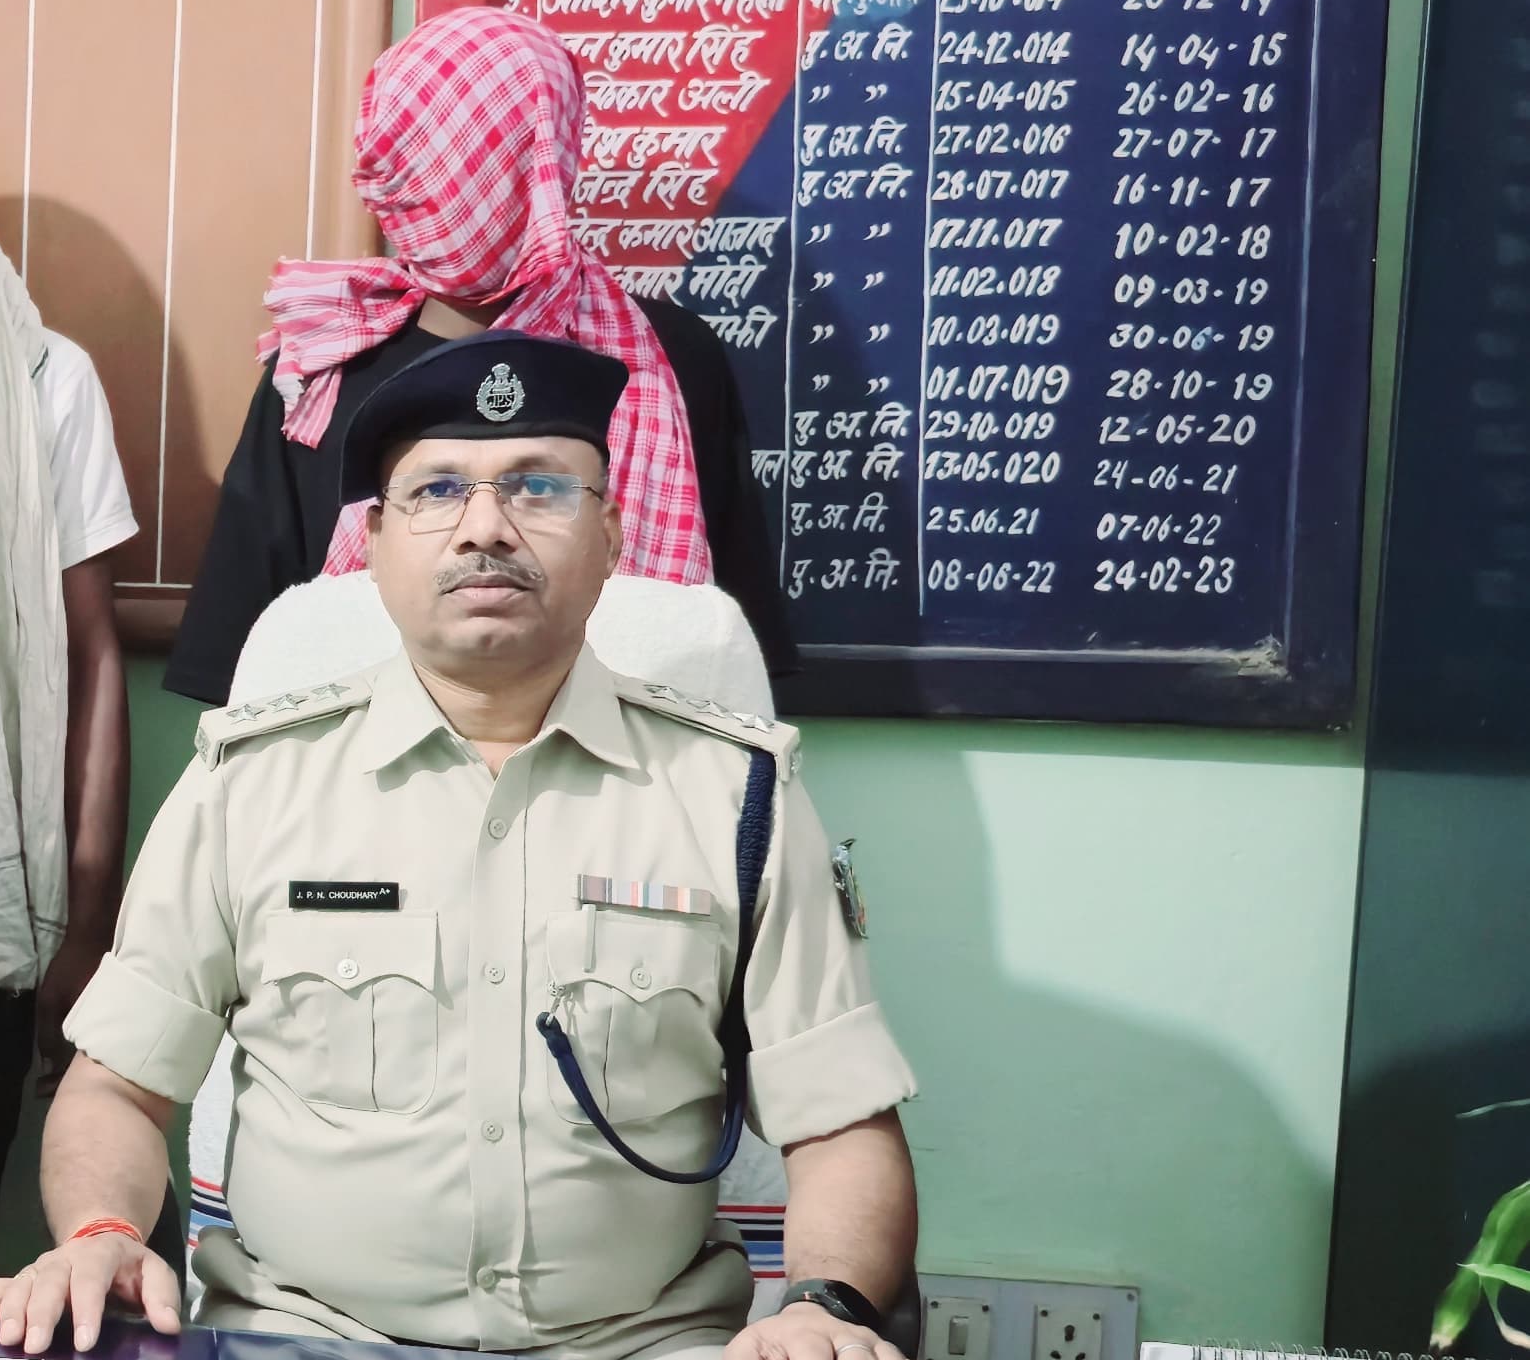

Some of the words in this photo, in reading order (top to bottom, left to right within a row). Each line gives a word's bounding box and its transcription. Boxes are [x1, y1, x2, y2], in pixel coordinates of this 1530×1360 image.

[686, 24, 765, 74] सिंह
[678, 72, 770, 115] अली
[643, 163, 719, 210] सिंह
[690, 256, 767, 307] मोदी
